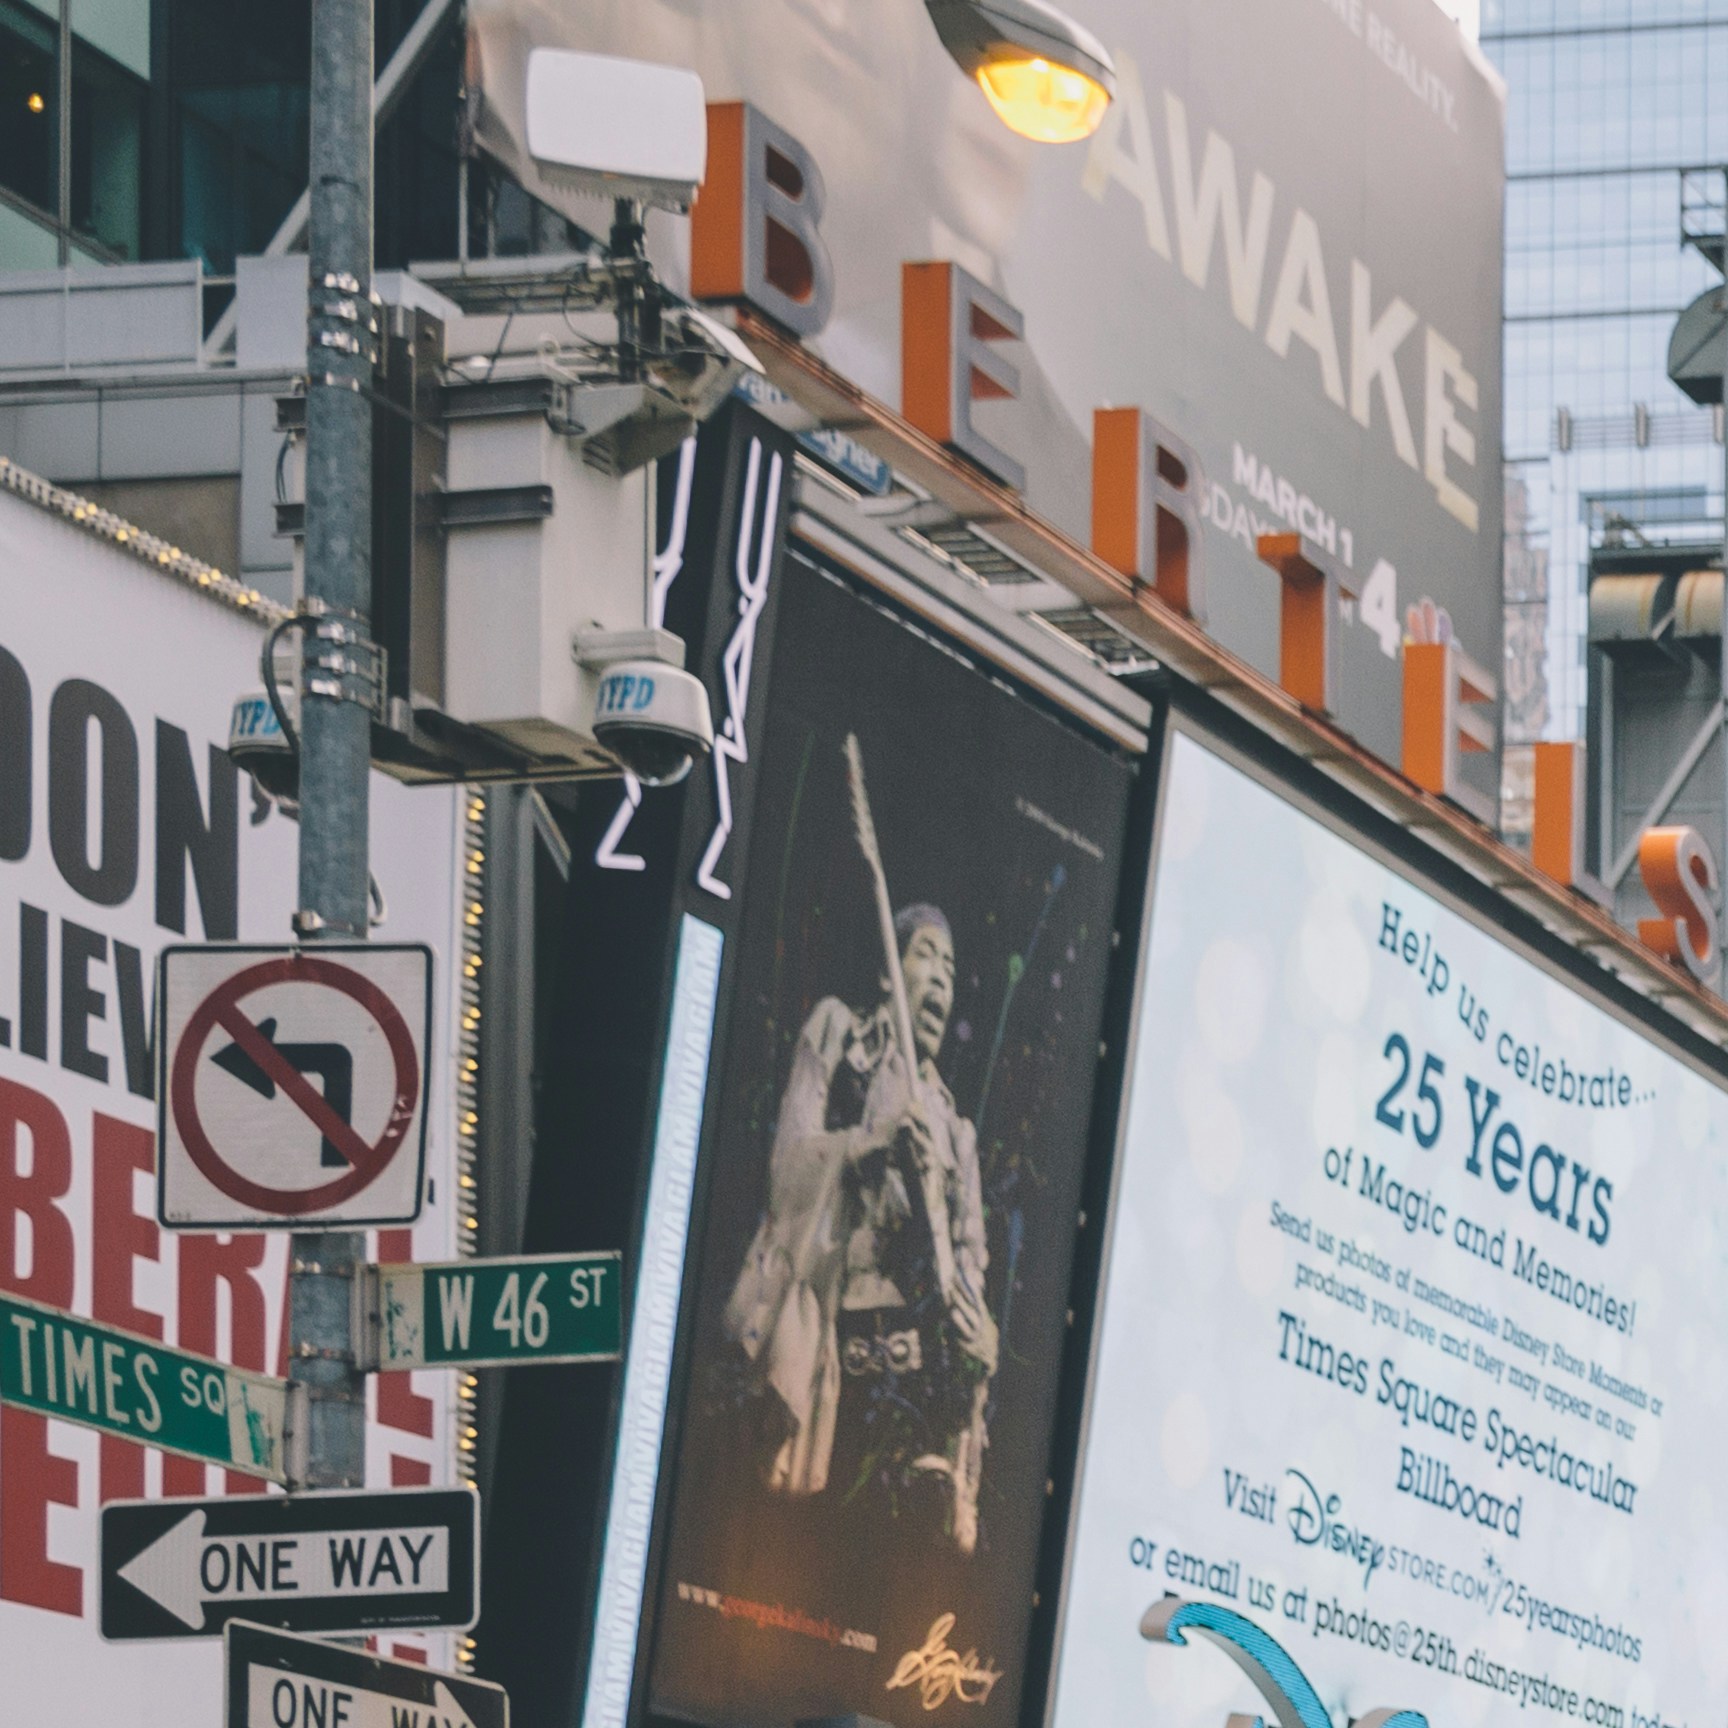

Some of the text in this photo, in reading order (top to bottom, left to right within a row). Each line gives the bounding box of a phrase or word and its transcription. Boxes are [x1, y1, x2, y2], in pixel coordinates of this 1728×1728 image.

[1082, 48, 1478, 533] AWAKE
[1235, 442, 1353, 567] MARCH 1
[1378, 902, 1450, 997] Help
[1458, 983, 1491, 1042] us
[1375, 1032, 1615, 1248] 25 Years
[1269, 1201, 1313, 1244] Send
[1316, 1228, 1336, 1256] us
[1338, 1241, 1392, 1284] photos
[1413, 1278, 1499, 1336] memorable
[1503, 1316, 1551, 1367] Disney
[1553, 1342, 1586, 1376] Store
[1589, 1361, 1649, 1406] Moments
[1324, 1146, 1638, 1338] of Magic and Memories!
[10, 1313, 226, 1433] TIMES SQ
[438, 1267, 607, 1350] W 46 ST
[1295, 1262, 1368, 1314] products
[1372, 1296, 1400, 1329] you
[1404, 1310, 1437, 1346] love
[1440, 1330, 1470, 1363] and
[1473, 1343, 1505, 1381] they
[1508, 1363, 1540, 1401] may
[1544, 1380, 1593, 1421] appear
[1278, 1310, 1639, 1516] Times Square Spectacular
[1223, 1468, 1277, 1526] Visit
[1397, 1446, 1523, 1539] Billboard
[200, 1534, 434, 1594] ONE WAY
[1129, 1536, 1159, 1572] or
[1165, 1547, 1240, 1601] email
[1249, 1576, 1276, 1613] us
[1283, 1584, 1308, 1624] at
